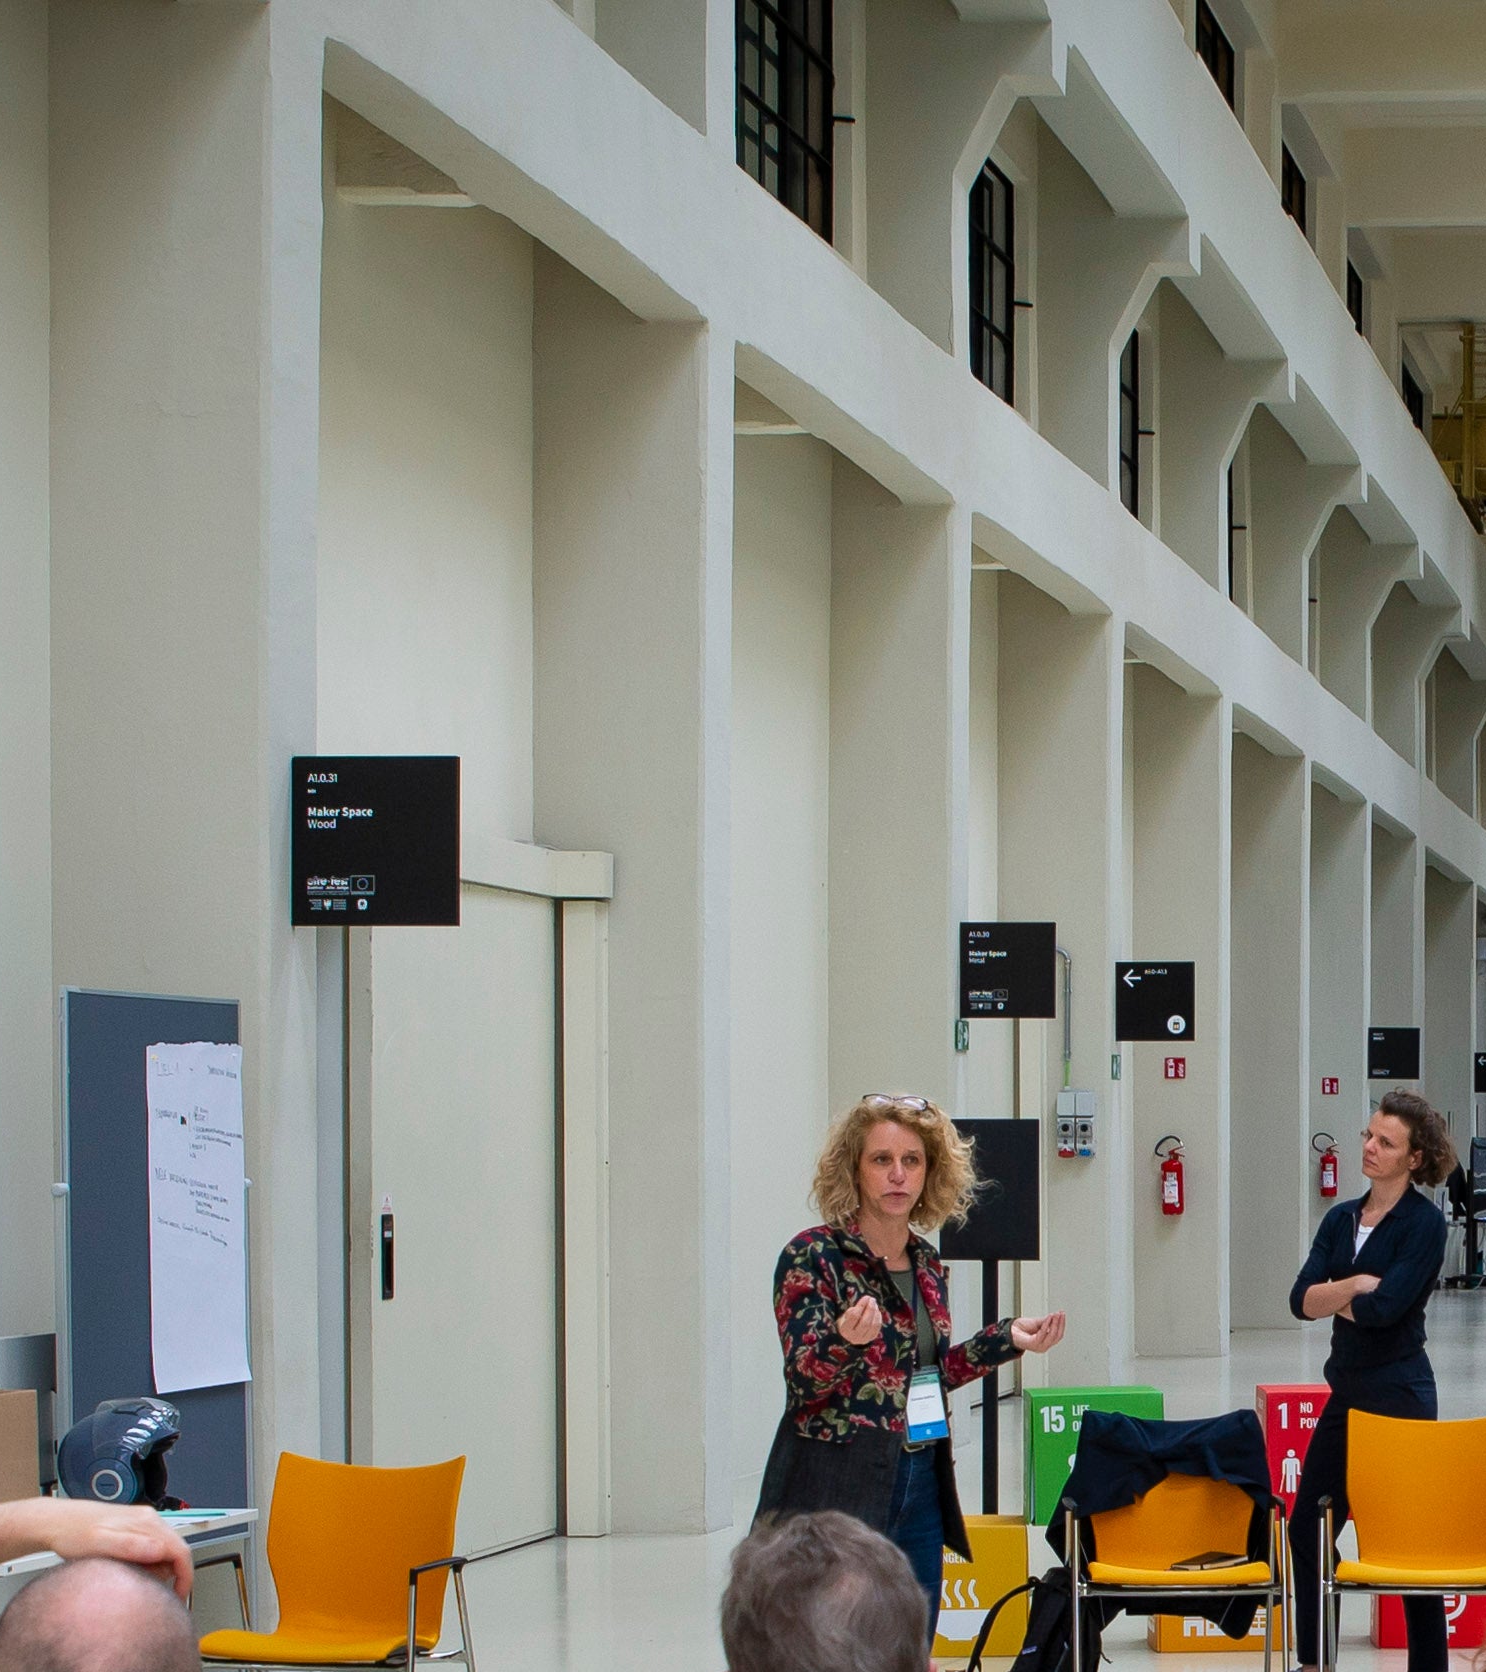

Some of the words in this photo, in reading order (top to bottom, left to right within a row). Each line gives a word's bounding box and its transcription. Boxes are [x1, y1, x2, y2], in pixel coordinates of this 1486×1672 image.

[307, 773, 338, 783] A1.0.31
[307, 807, 340, 817] Maker
[341, 807, 374, 819] Space
[307, 819, 337, 829] Wood
[1040, 1406, 1065, 1433] 15
[1278, 1402, 1288, 1429] 1
[1300, 1401, 1313, 1413] NO
